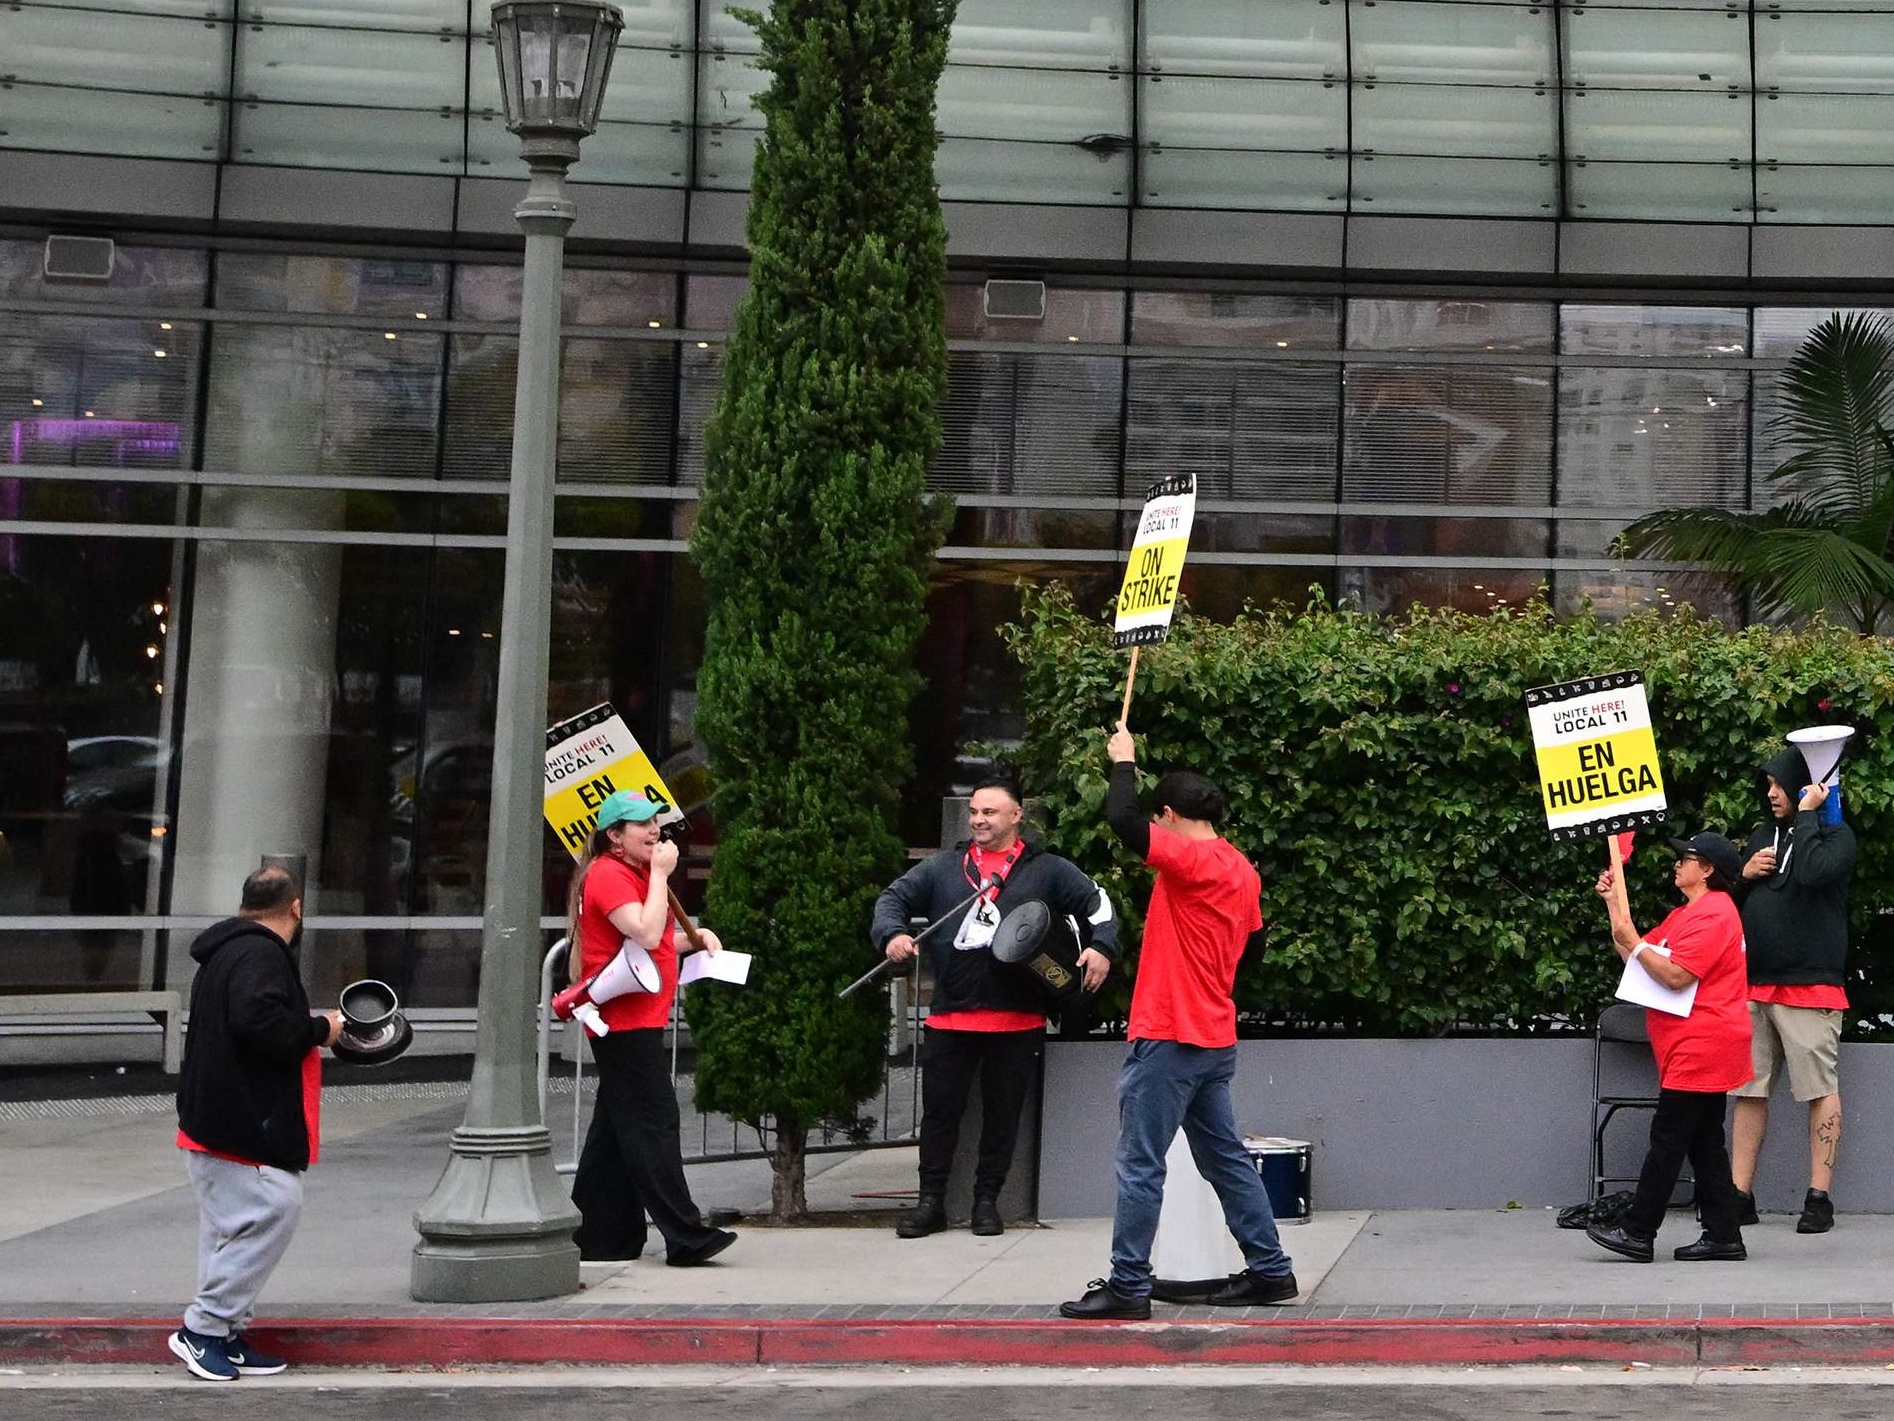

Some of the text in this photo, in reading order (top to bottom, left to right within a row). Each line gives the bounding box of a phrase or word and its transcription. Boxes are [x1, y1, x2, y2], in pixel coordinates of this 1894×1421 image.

[1143, 517, 1179, 535] LOCAL 11
[1147, 509, 1161, 521] UNITE
[1141, 546, 1164, 578] ON
[1121, 575, 1176, 612] STRIKE
[1553, 700, 1625, 722] UNITE HERE!
[1555, 710, 1628, 734] LOCAL 11
[574, 734, 608, 756] HERE!
[1578, 741, 1615, 772] EN
[545, 743, 615, 783] LOCAL 11
[576, 774, 616, 810] EN
[1547, 764, 1657, 808] HUELGA
